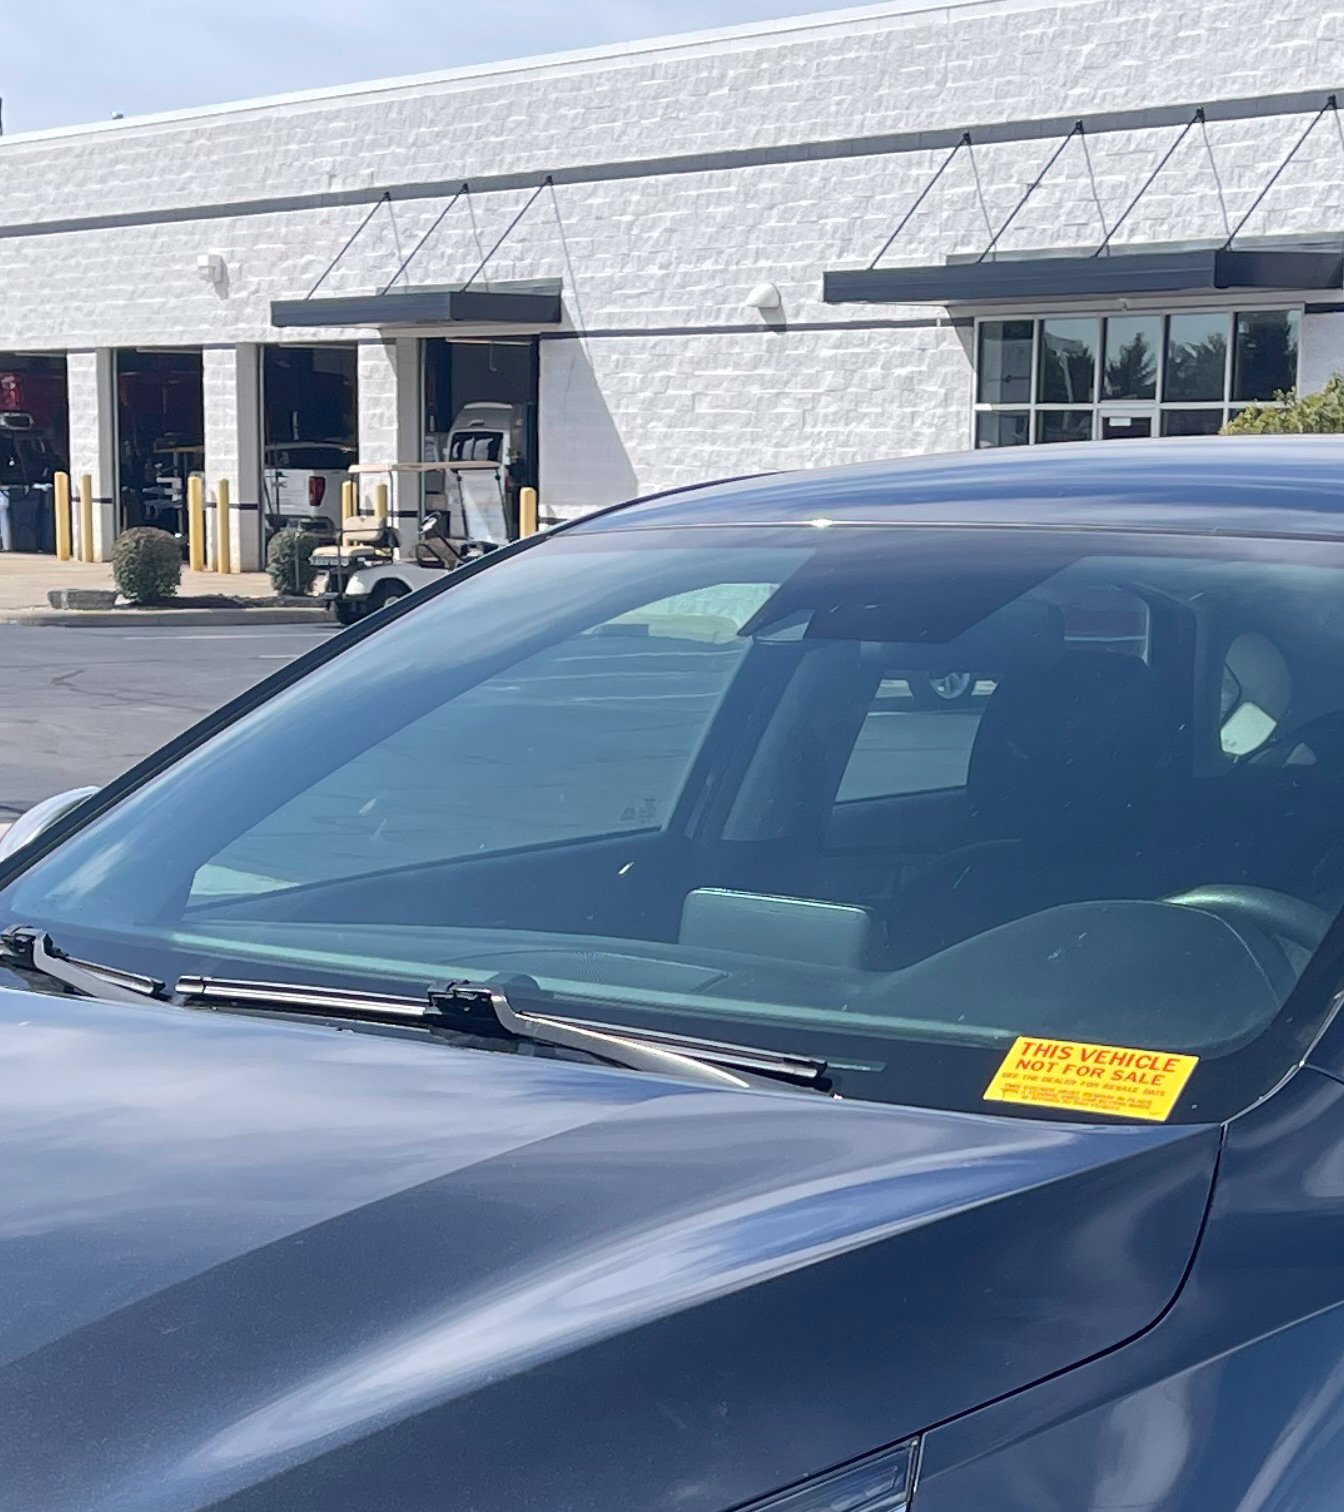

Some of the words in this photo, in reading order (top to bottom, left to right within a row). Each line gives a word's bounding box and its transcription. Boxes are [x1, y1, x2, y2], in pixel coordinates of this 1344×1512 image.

[1021, 1041, 1074, 1060] THIS
[1080, 1047, 1181, 1073] VEHICLE
[1015, 1058, 1059, 1073] NOT
[1062, 1063, 1106, 1079] FOR
[1110, 1069, 1166, 1086] SALE
[1041, 1076, 1077, 1085] DEALER
[1102, 1083, 1139, 1093] RESALE
